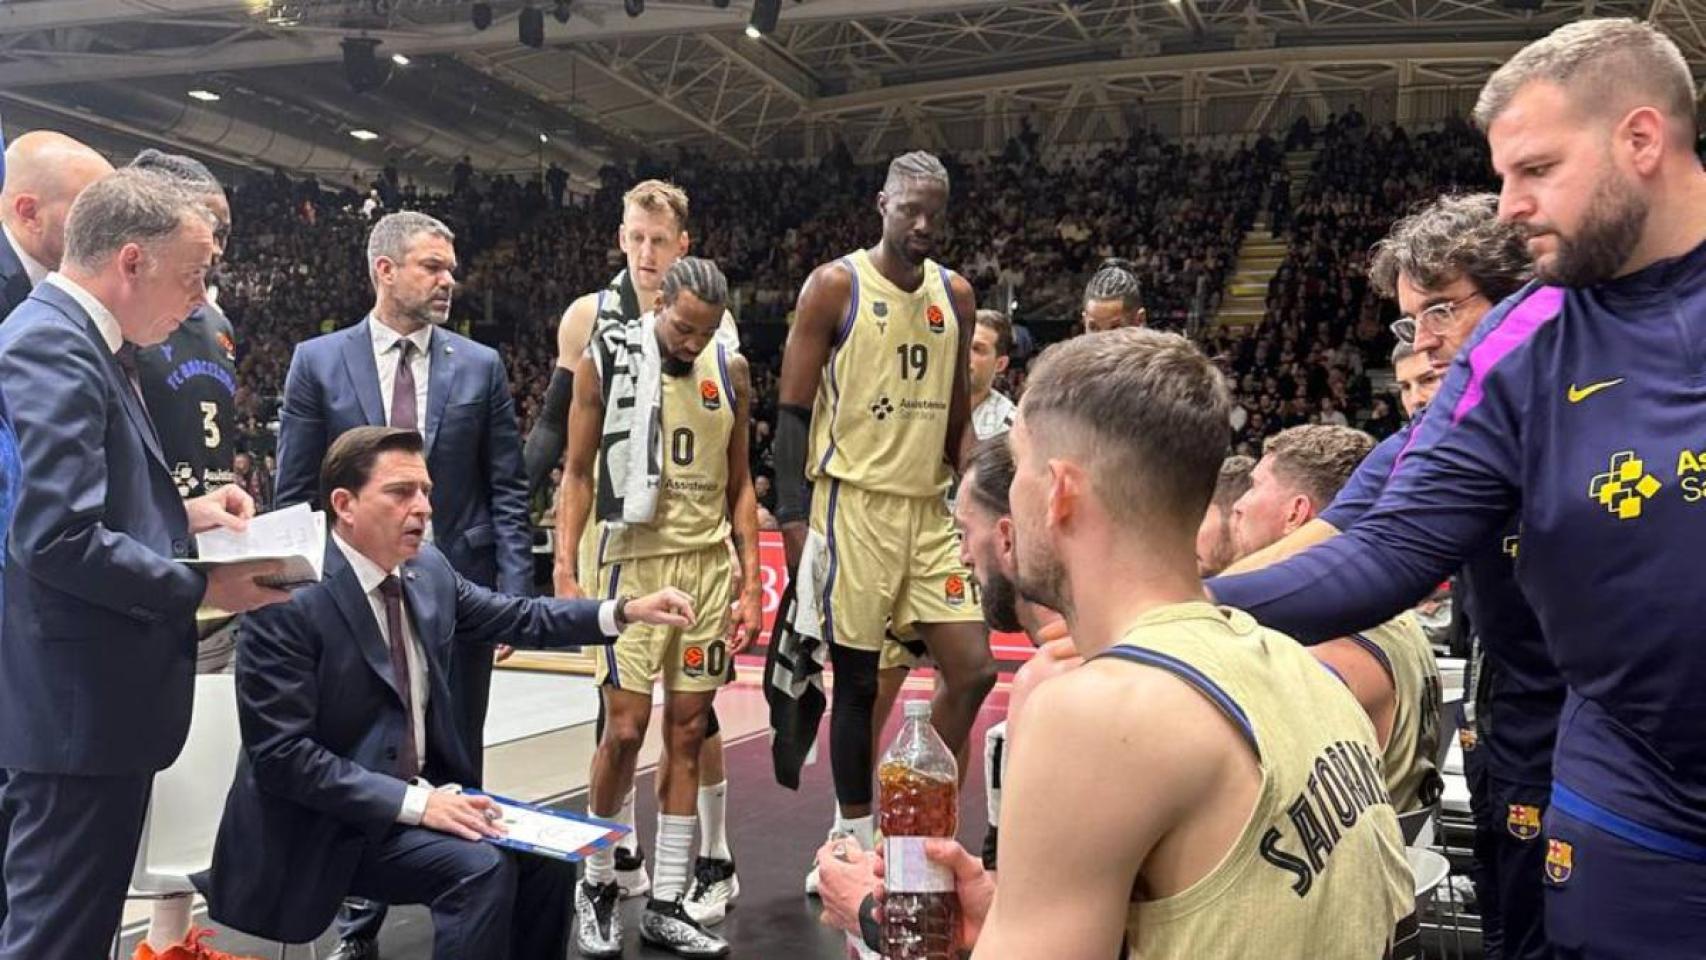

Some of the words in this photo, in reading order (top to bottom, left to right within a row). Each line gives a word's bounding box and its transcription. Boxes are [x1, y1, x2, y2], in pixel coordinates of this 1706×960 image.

[896, 343, 928, 380] 19
[200, 401, 220, 448] 3
[672, 427, 694, 466] 0
[707, 639, 726, 676] 0
